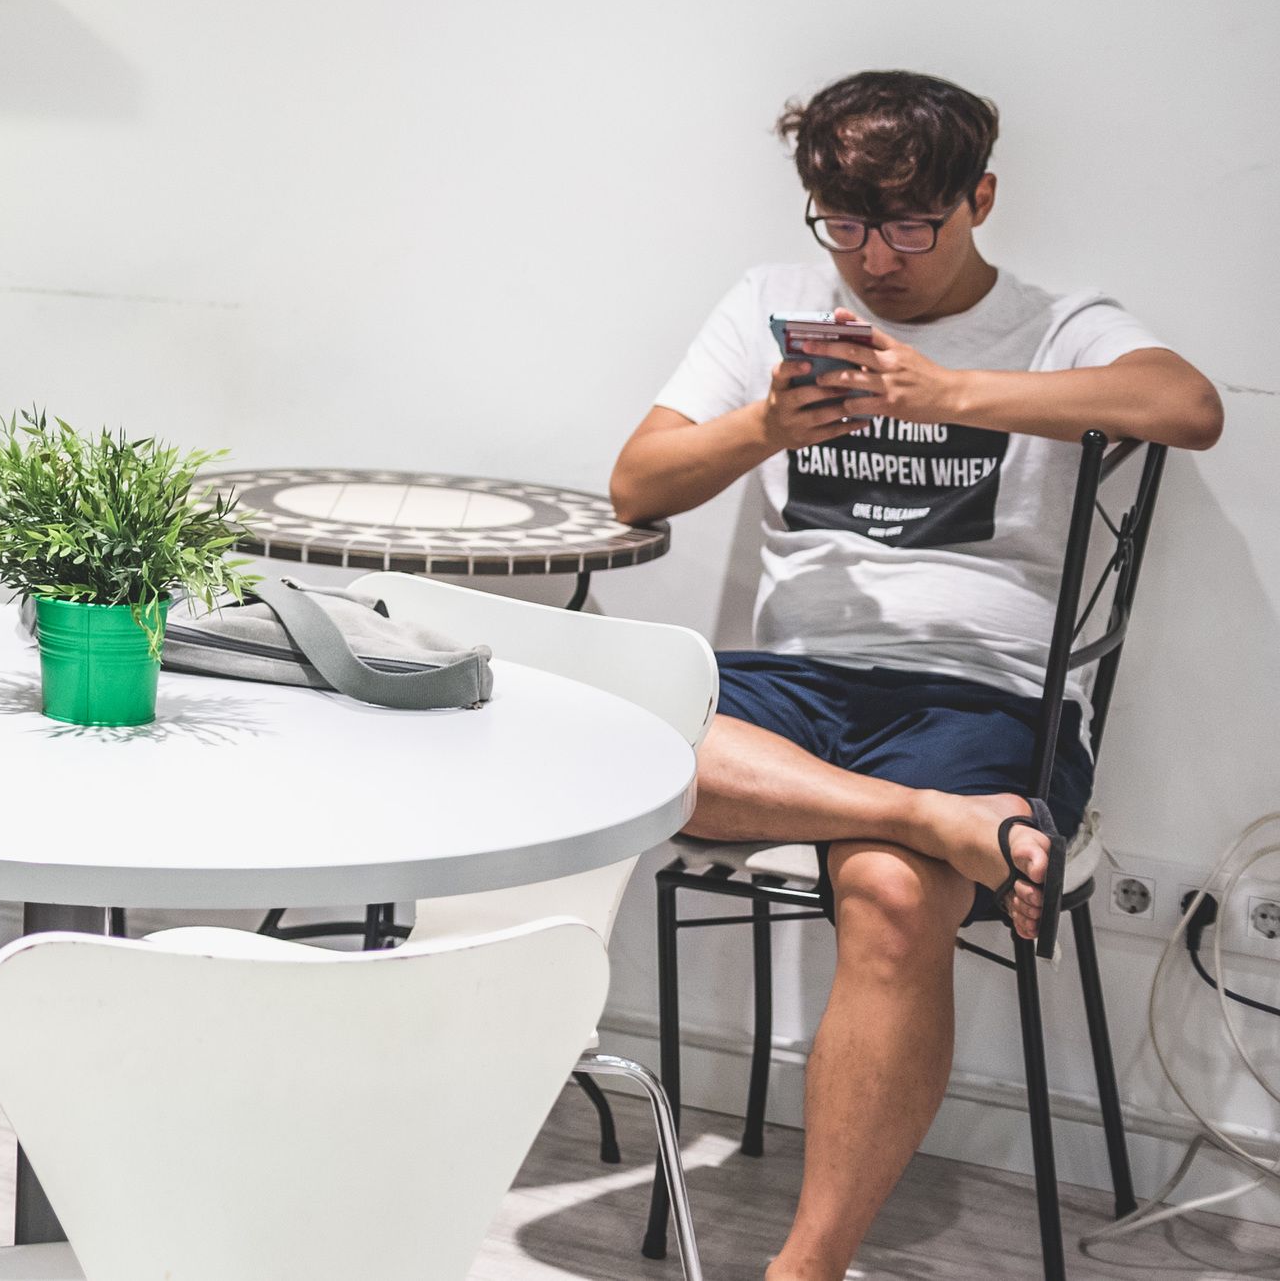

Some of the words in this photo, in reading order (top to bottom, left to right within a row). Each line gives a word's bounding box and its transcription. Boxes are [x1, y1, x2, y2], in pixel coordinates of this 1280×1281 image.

[849, 415, 949, 443] NYTHING
[796, 445, 839, 478] CAN
[841, 449, 927, 487] HAPPEN
[930, 456, 998, 488] WHEN
[852, 502, 872, 519] ONE
